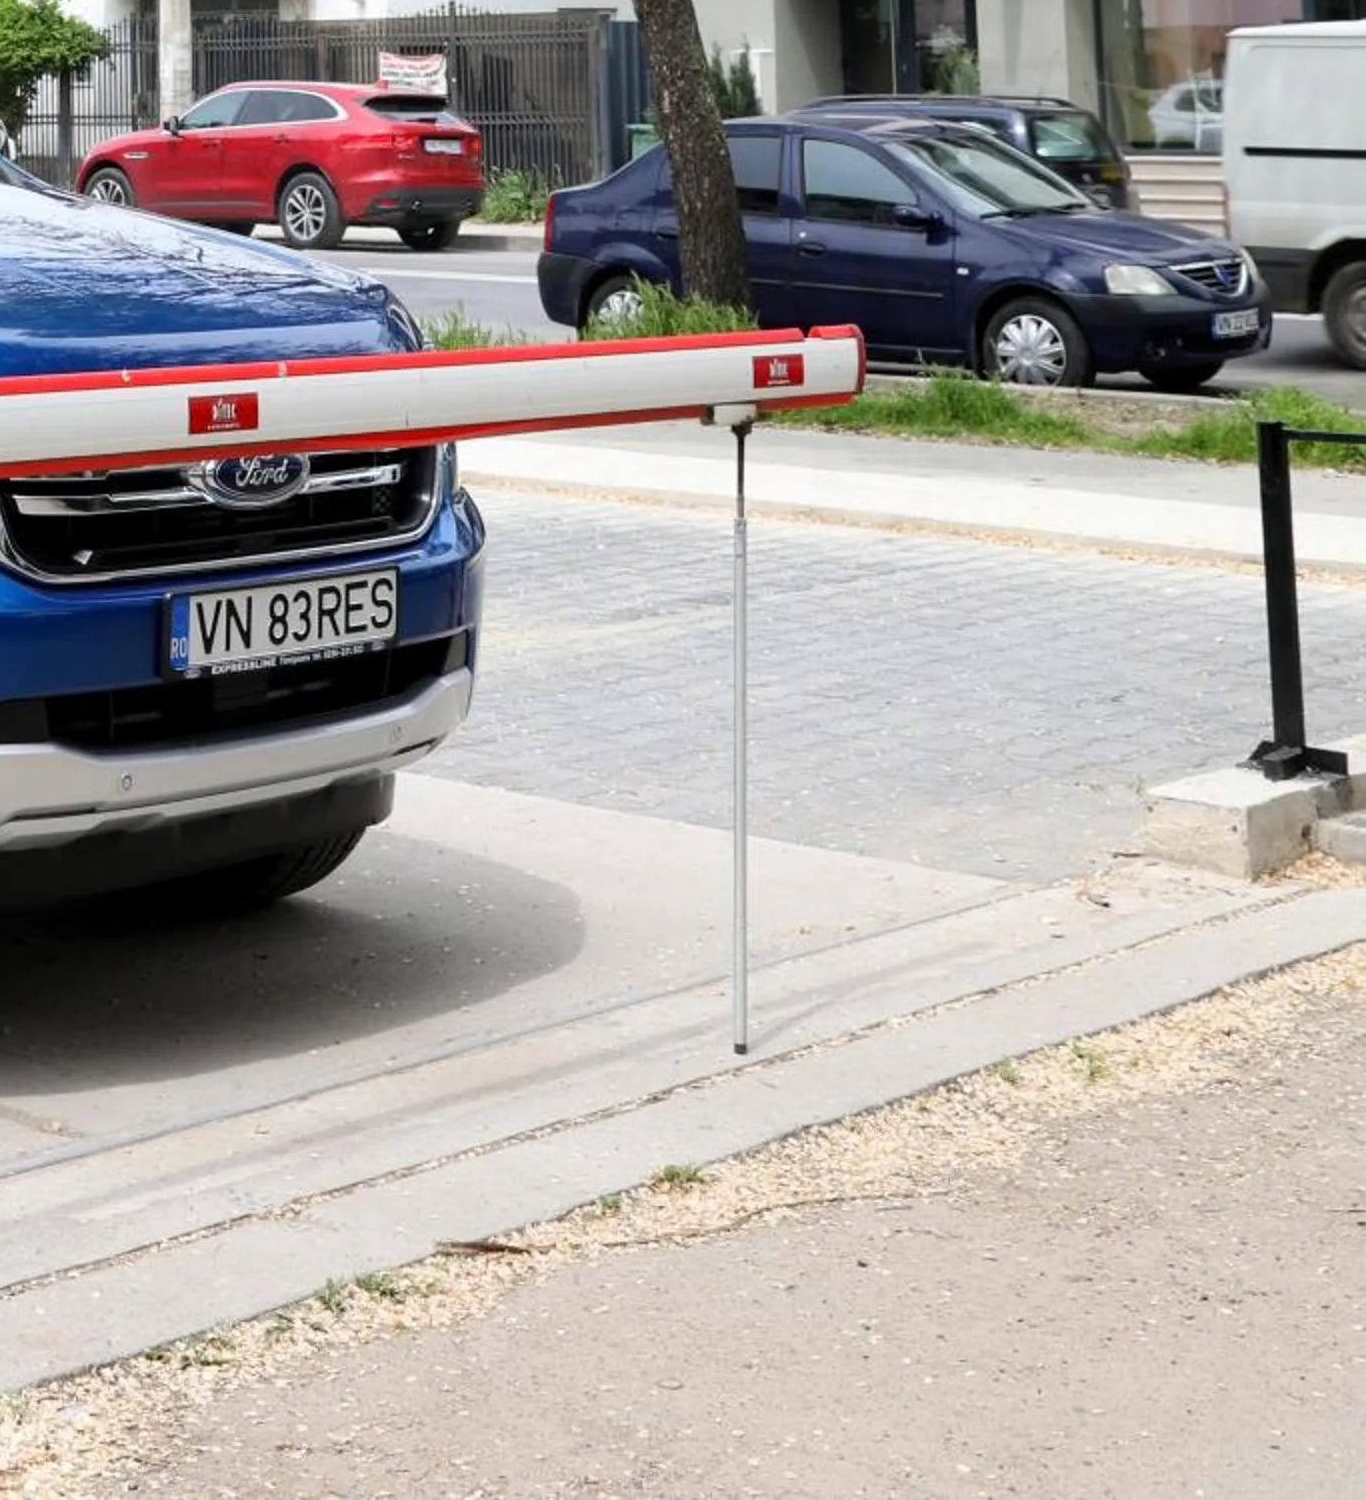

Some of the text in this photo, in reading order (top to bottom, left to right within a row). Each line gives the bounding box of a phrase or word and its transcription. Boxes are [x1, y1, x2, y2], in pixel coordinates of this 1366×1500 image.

[235, 453, 289, 487] Ford
[196, 596, 252, 654] VN
[268, 578, 394, 645] 83RES
